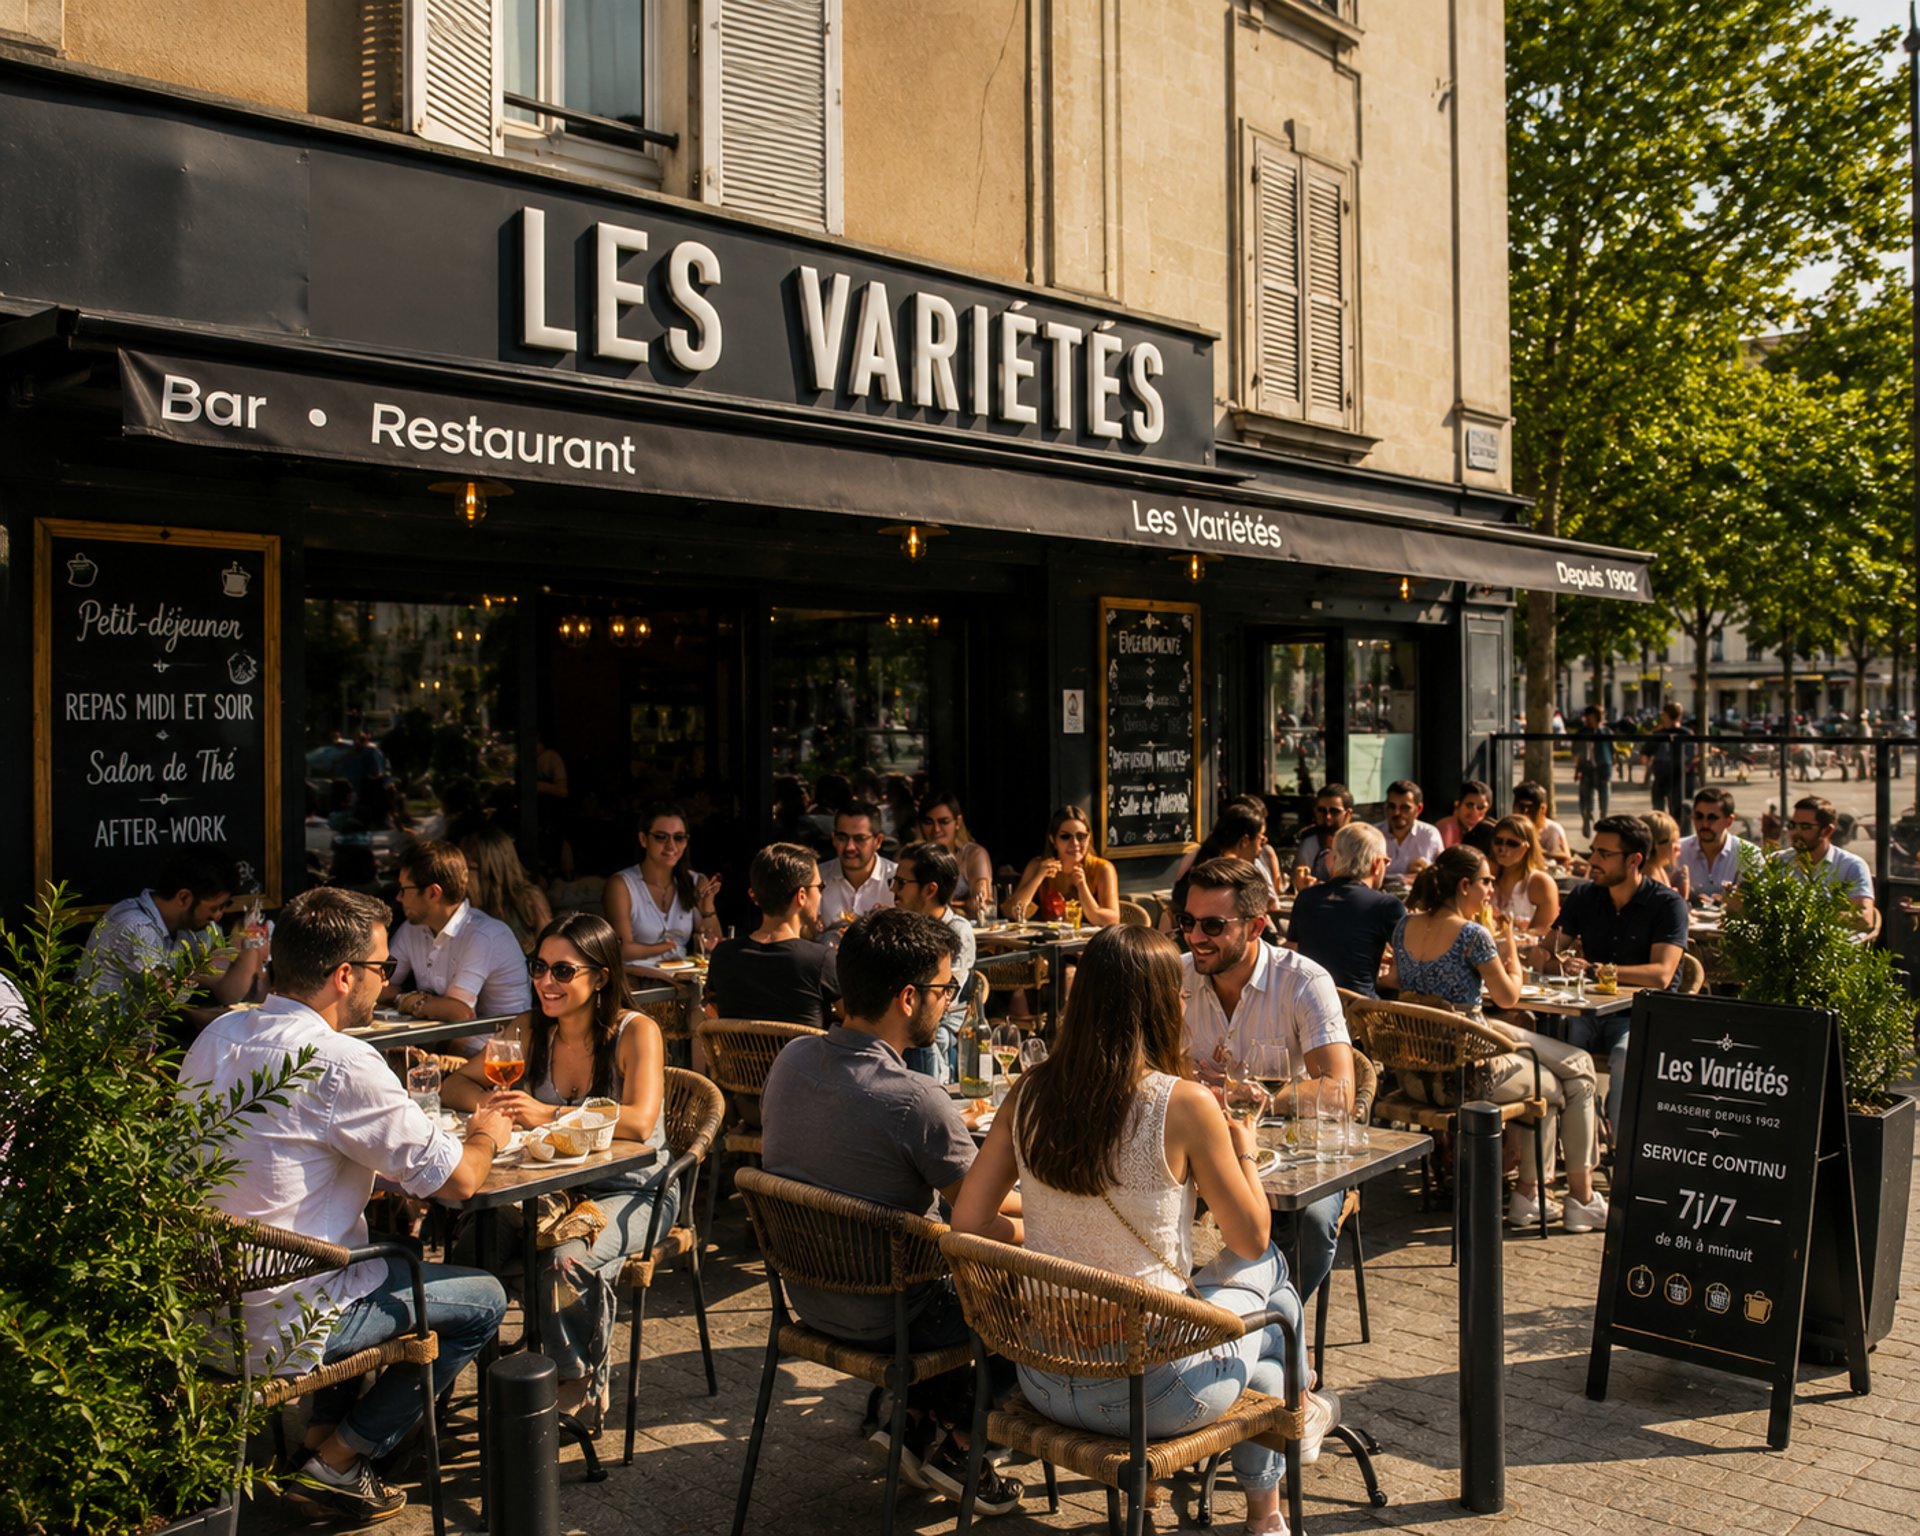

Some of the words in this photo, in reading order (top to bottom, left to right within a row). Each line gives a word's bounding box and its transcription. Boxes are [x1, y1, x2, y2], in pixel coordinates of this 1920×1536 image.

[520, 206, 722, 373] LES
[799, 265, 1165, 446] VARIÉTÉS
[161, 374, 267, 429] Bar
[371, 402, 636, 475] Restaurant
[1132, 499, 1178, 536] Les
[1181, 505, 1282, 548] Variétés
[1556, 561, 1605, 591] Depuis
[1605, 568, 1639, 592] 1902
[76, 599, 243, 653] Petit-déjeuner
[66, 693, 127, 721] REPAS
[136, 693, 175, 721] MIDI
[184, 693, 207, 720] ET
[214, 693, 254, 721] SOIR
[86, 749, 155, 785] Salon
[162, 751, 188, 782] de
[196, 747, 238, 783] Thé
[94, 815, 227, 848] AFTER-WORK
[1657, 1051, 1694, 1083] Les
[1700, 1056, 1789, 1097] Variétés
[1656, 1101, 1712, 1119] BRASSERIE
[1715, 1110, 1752, 1125] DEPUIS
[1641, 1142, 1708, 1167] SERVICE
[1712, 1154, 1787, 1180] CONTINU
[1678, 1188, 1737, 1230] 7j/7
[1655, 1231, 1672, 1247] de
[1674, 1235, 1692, 1250] 8h
[1695, 1238, 1704, 1252] à
